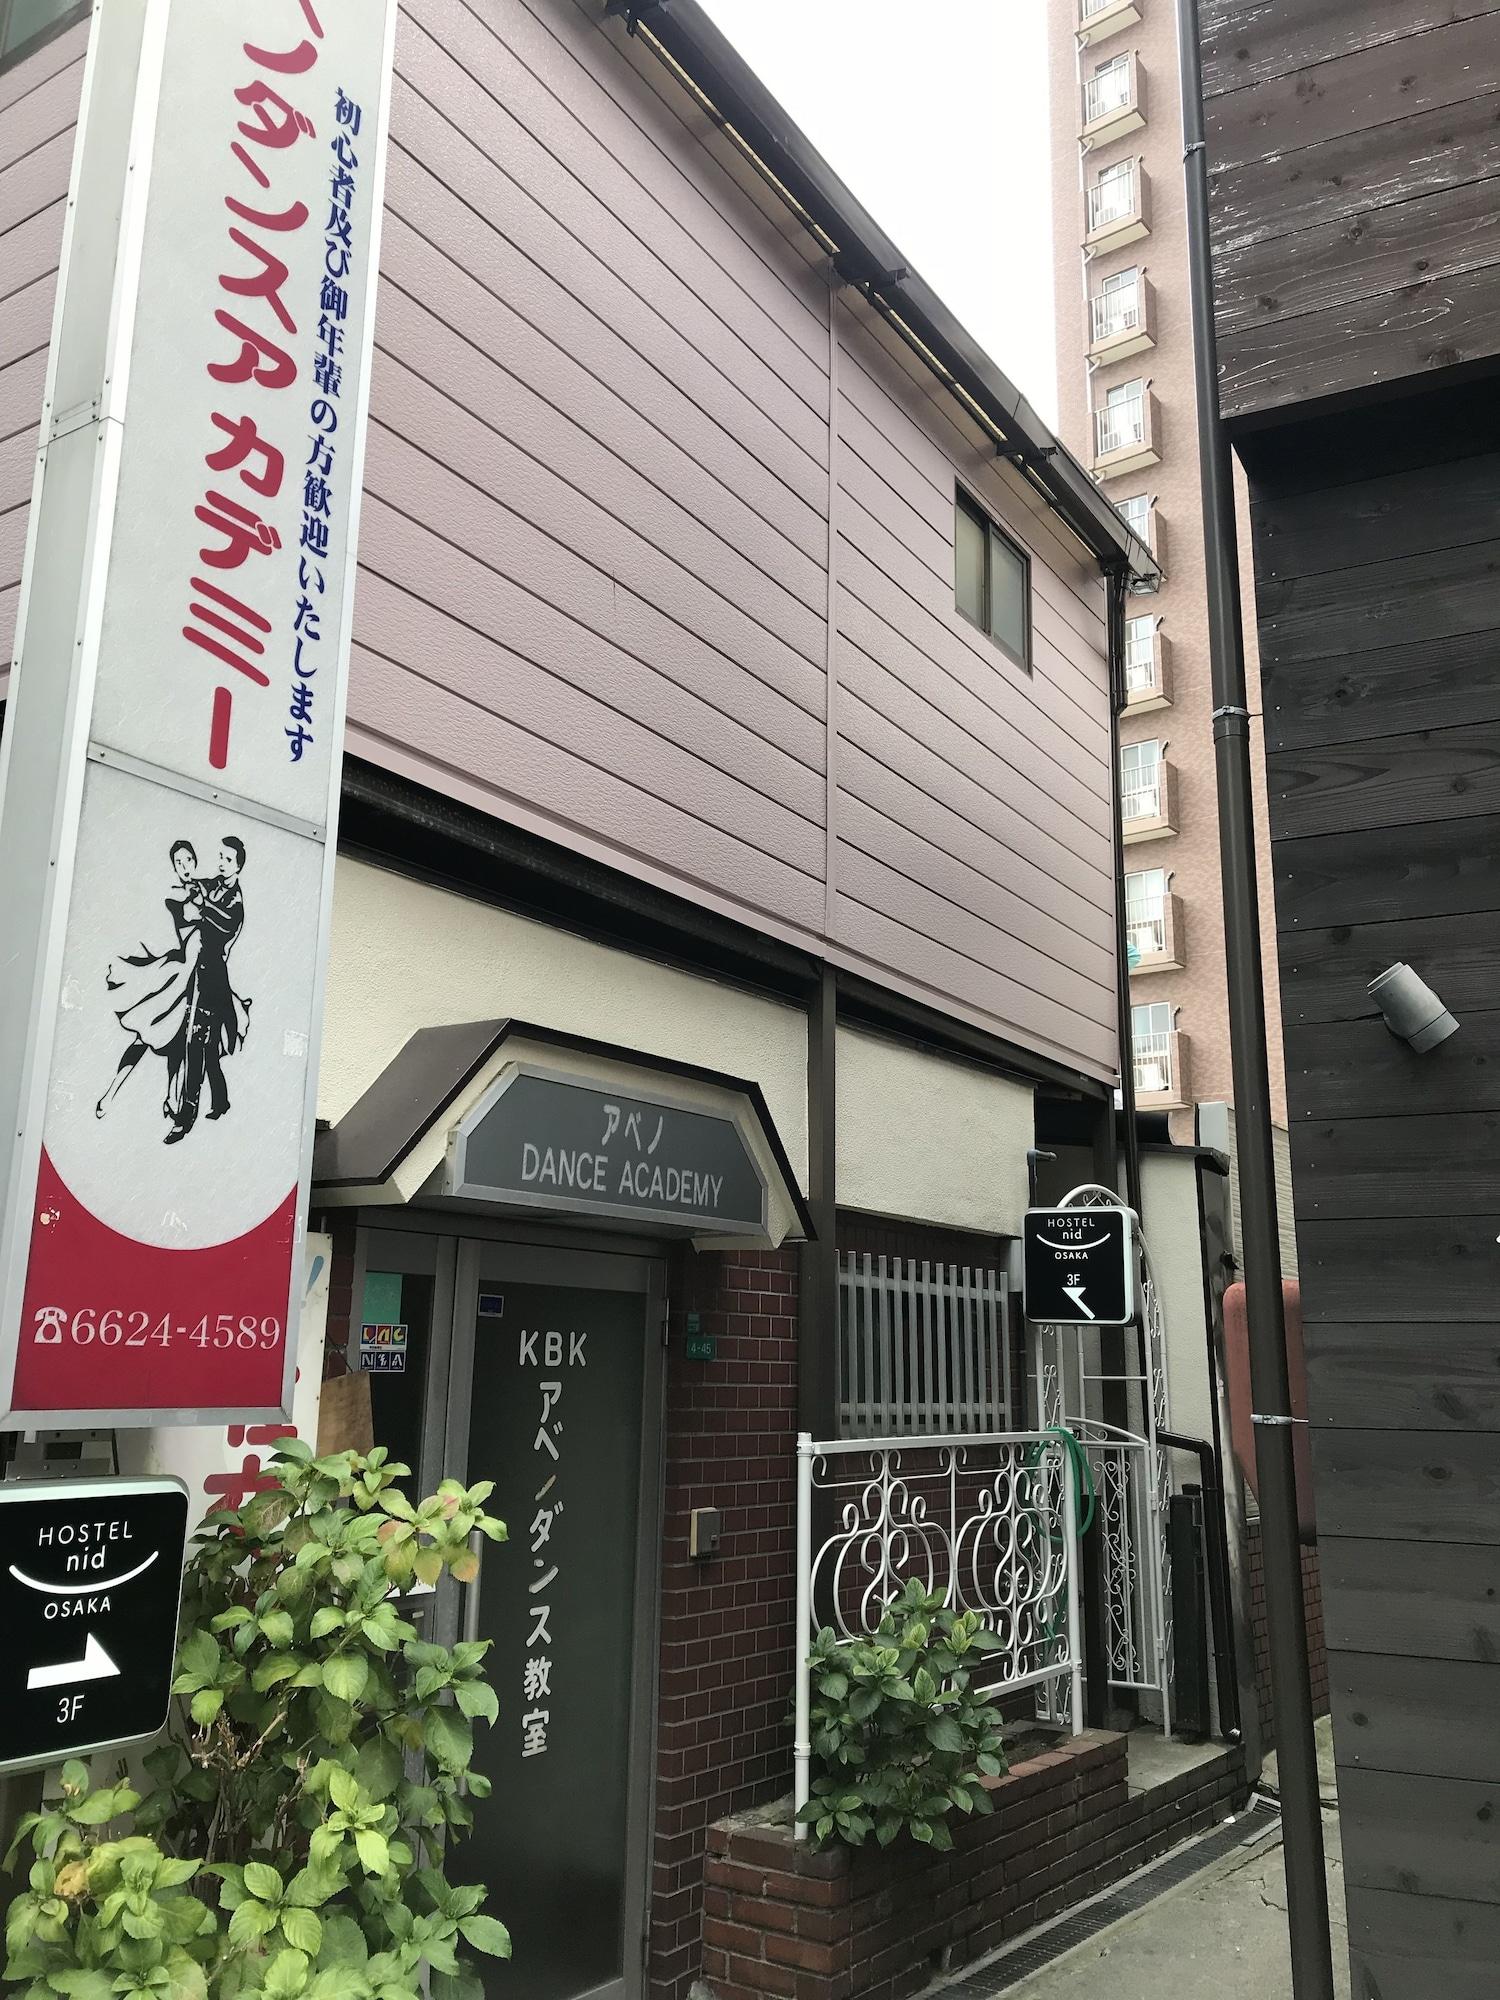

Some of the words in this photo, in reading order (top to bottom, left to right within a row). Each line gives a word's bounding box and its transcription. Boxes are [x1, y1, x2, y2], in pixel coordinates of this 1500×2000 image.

[284, 86, 361, 762] 初心者及び御年輩の方歓迎いたします
[602, 1104, 663, 1154] アベノ
[521, 1143, 609, 1192] DANCE
[618, 1160, 723, 1208] ACADEMY
[1047, 1218, 1096, 1228] HOSTEL
[1062, 1228, 1083, 1240] nid
[1054, 1251, 1089, 1260] OSAKA
[1066, 1273, 1081, 1286] 3F
[71, 1308, 281, 1351] 6624-4589
[519, 1329, 587, 1367] KBK
[690, 1343, 712, 1354] 4-45
[38, 1520, 133, 1546] HOSTEL
[66, 1545, 107, 1572] nid
[44, 1596, 112, 1620] OSAKA
[56, 1694, 85, 1724] 3F
